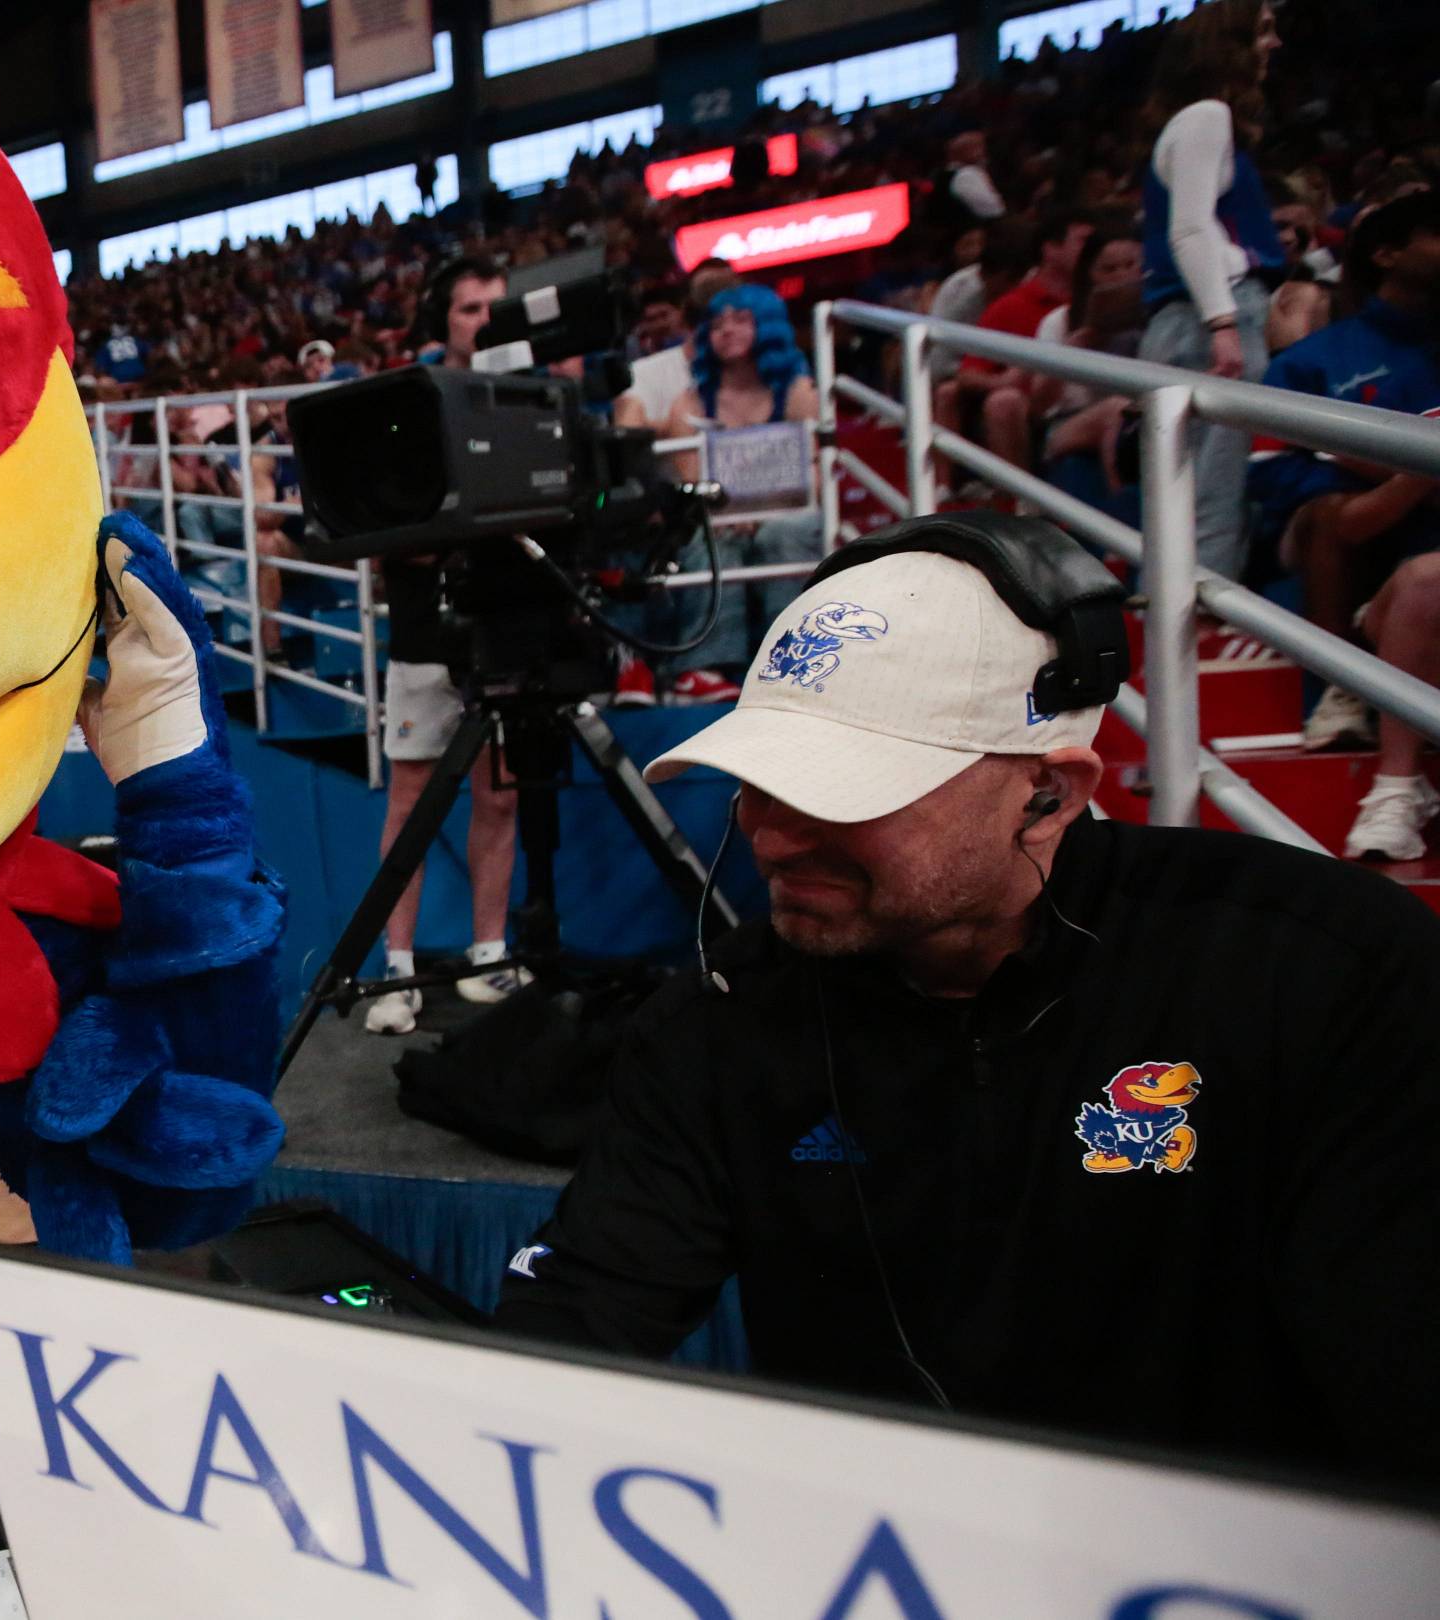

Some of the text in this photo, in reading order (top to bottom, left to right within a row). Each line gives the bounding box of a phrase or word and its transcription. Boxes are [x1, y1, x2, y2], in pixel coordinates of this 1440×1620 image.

[690, 88, 732, 122] 22
[786, 641, 815, 660] KU
[1114, 1121, 1155, 1144] KU
